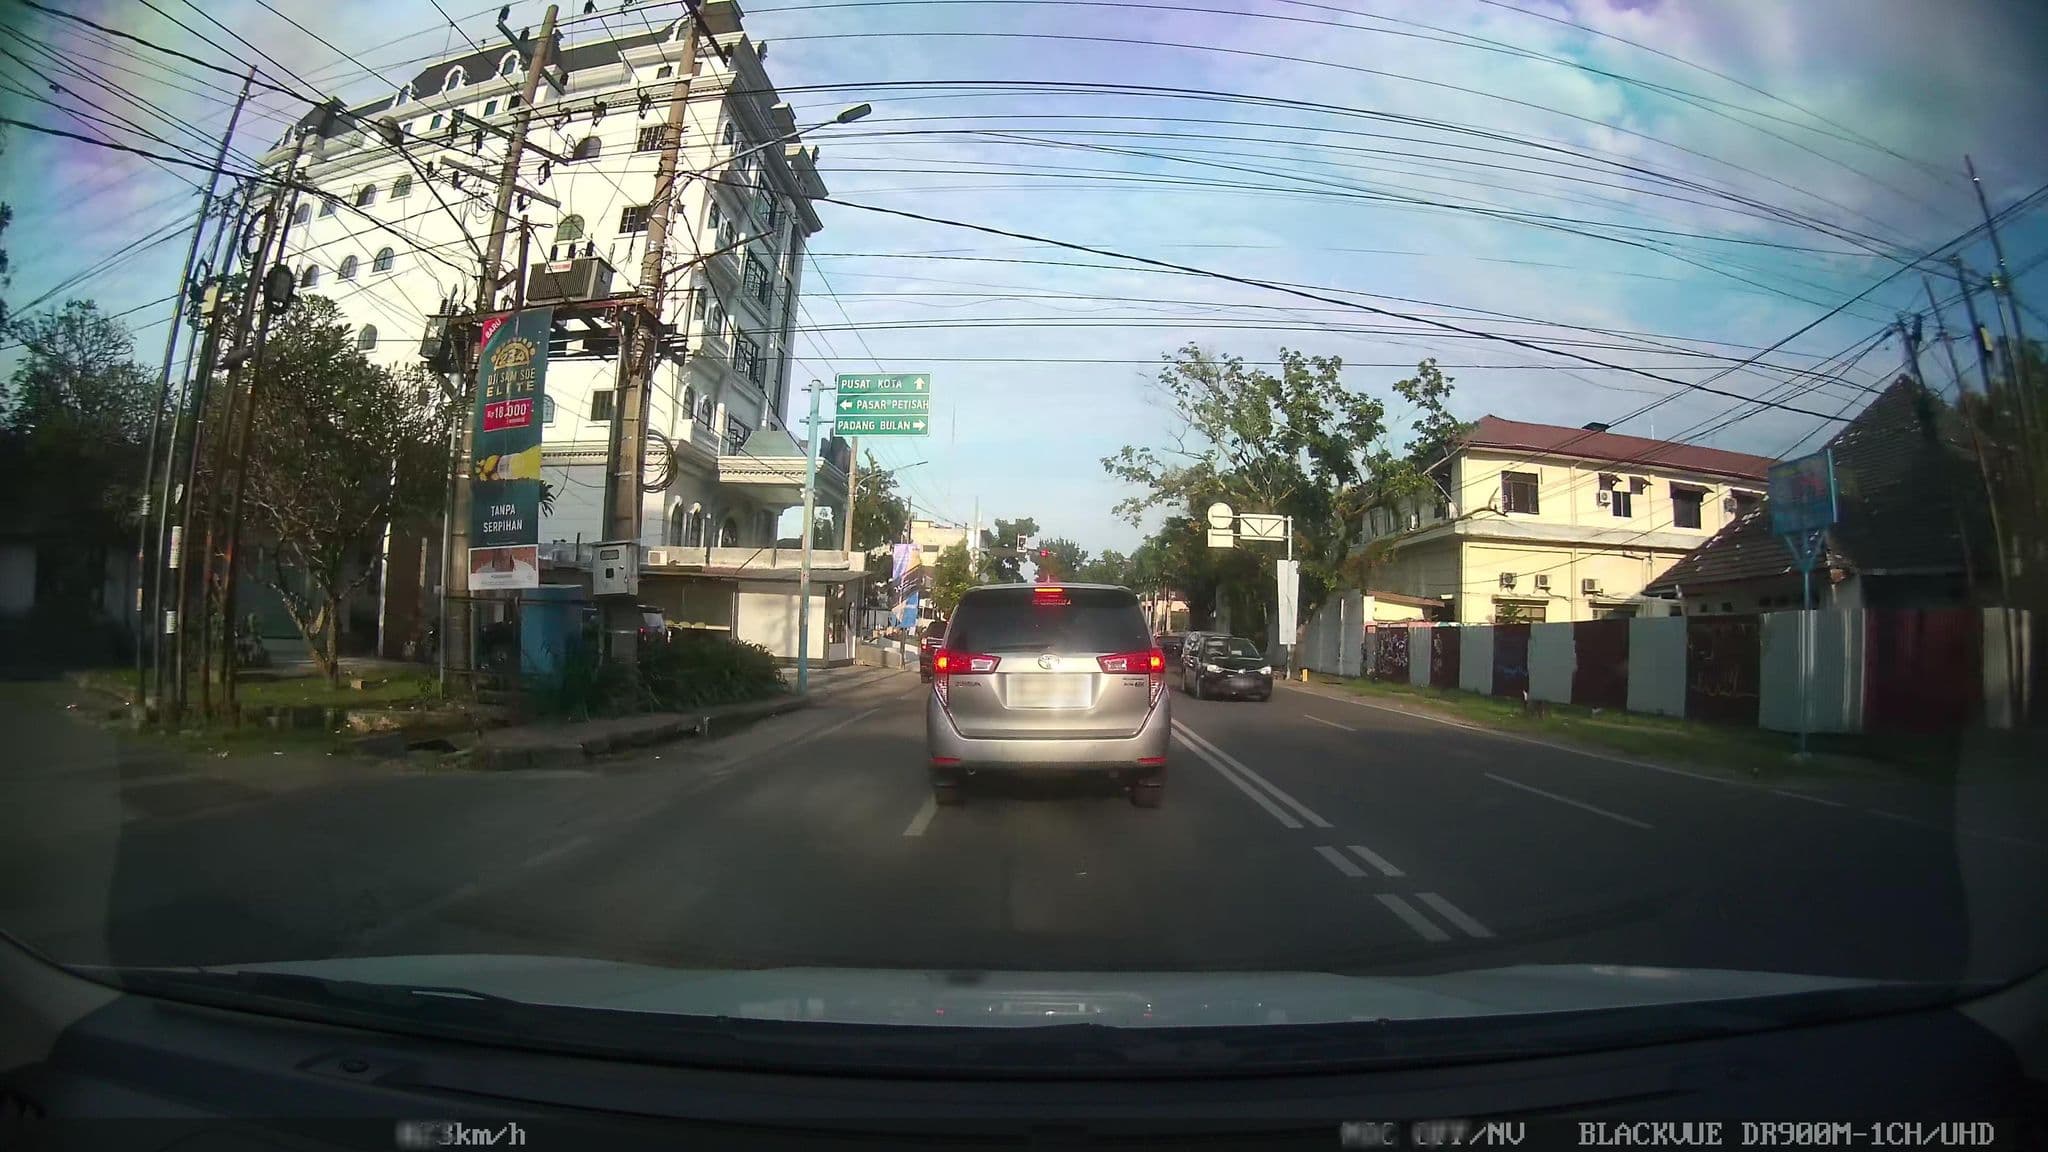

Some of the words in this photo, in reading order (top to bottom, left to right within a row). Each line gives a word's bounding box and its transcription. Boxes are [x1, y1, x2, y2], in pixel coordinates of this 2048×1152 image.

[485, 319, 502, 339] BARU
[520, 367, 536, 381] SOE
[486, 380, 535, 398] ELITE
[841, 379, 871, 389] PUSAT
[877, 379, 903, 389] KOTA
[856, 399, 887, 410] PASAR
[891, 399, 929, 410] PETISAH
[838, 420, 876, 431] PADANG
[879, 420, 911, 431] BULAN
[490, 503, 516, 517] TANPA
[483, 519, 523, 533] SERPIHAN
